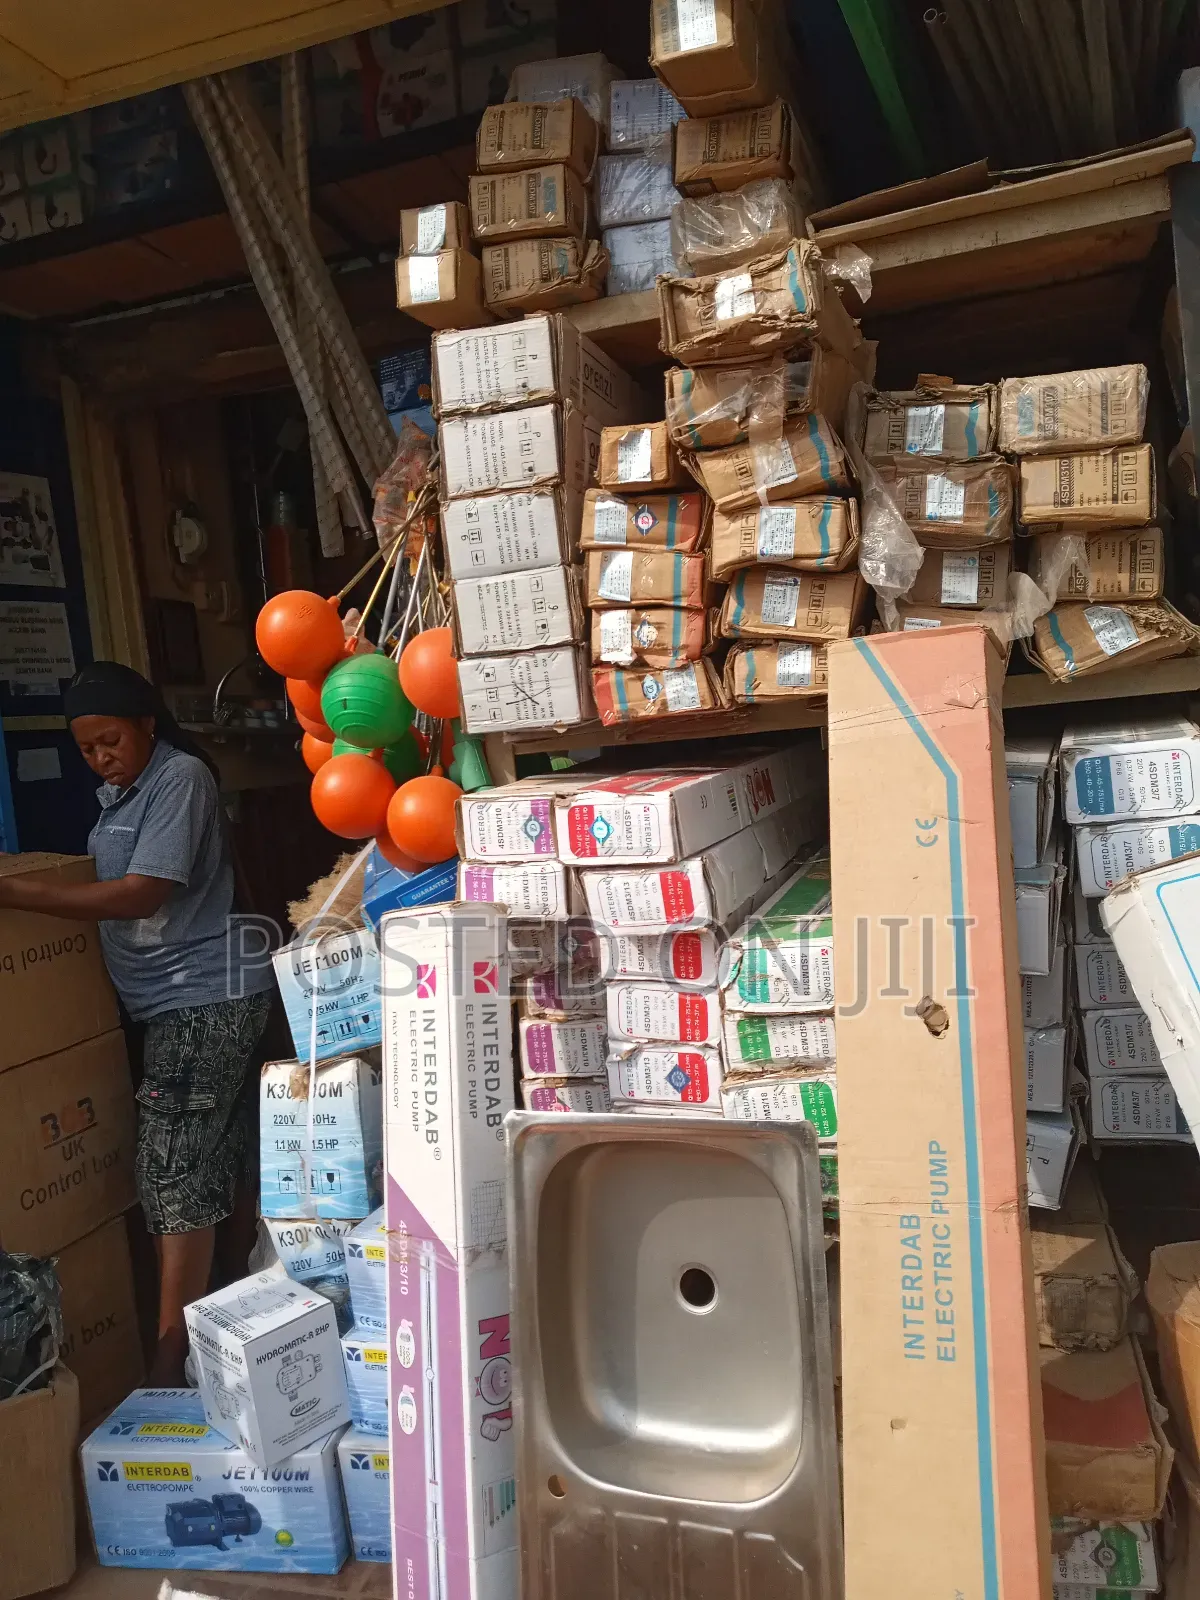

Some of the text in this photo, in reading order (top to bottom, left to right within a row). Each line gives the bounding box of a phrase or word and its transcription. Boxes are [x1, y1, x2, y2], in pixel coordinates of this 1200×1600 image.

[1061, 459, 1070, 505] 4SDM310
[1149, 761, 1160, 801] 4SDM3/7
[496, 808, 504, 849] 4SDM3/10
[625, 810, 633, 851] 4SDM3/13
[1101, 835, 1112, 879] INTERDAB
[1124, 841, 1134, 872] SDM3/7
[411, 877, 449, 900] GUARANTEE
[624, 882, 635, 921] 4SDM3/13
[23, 933, 87, 973] Control
[340, 976, 364, 987] 50Hz
[801, 953, 810, 996] 4SDM3/18
[581, 1028, 589, 1067] 4SDM3/10
[1125, 1024, 1136, 1059] 4SDM3/7
[409, 1010, 419, 1132] ELECTRIC PUMP
[465, 1004, 478, 1120] ELECTRIC PUMP
[644, 1057, 652, 1095] 4SDM3/13
[274, 1115, 296, 1124] 220V
[1132, 1091, 1140, 1126] 4SDM3/7
[61, 1136, 85, 1162] UK
[20, 1160, 88, 1211] Control
[326, 1251, 345, 1263] 50H
[928, 1139, 957, 1363] ELECTRIC PUMP
[902, 1213, 926, 1360] INTERDAB
[81, 1312, 116, 1342] box
[256, 1331, 314, 1366] HYDROMATIC-R
[315, 1323, 330, 1337] 2HP
[294, 1398, 318, 1415] MATIC
[141, 1424, 205, 1435] INTERDAB
[125, 1465, 190, 1477] INTERDAB
[127, 1483, 194, 1493] ELETTROPOMPE
[239, 1485, 259, 1494] 100%
[260, 1485, 293, 1493] COPPER
[123, 1548, 137, 1557] ISO
[406, 1558, 416, 1589] BEST
